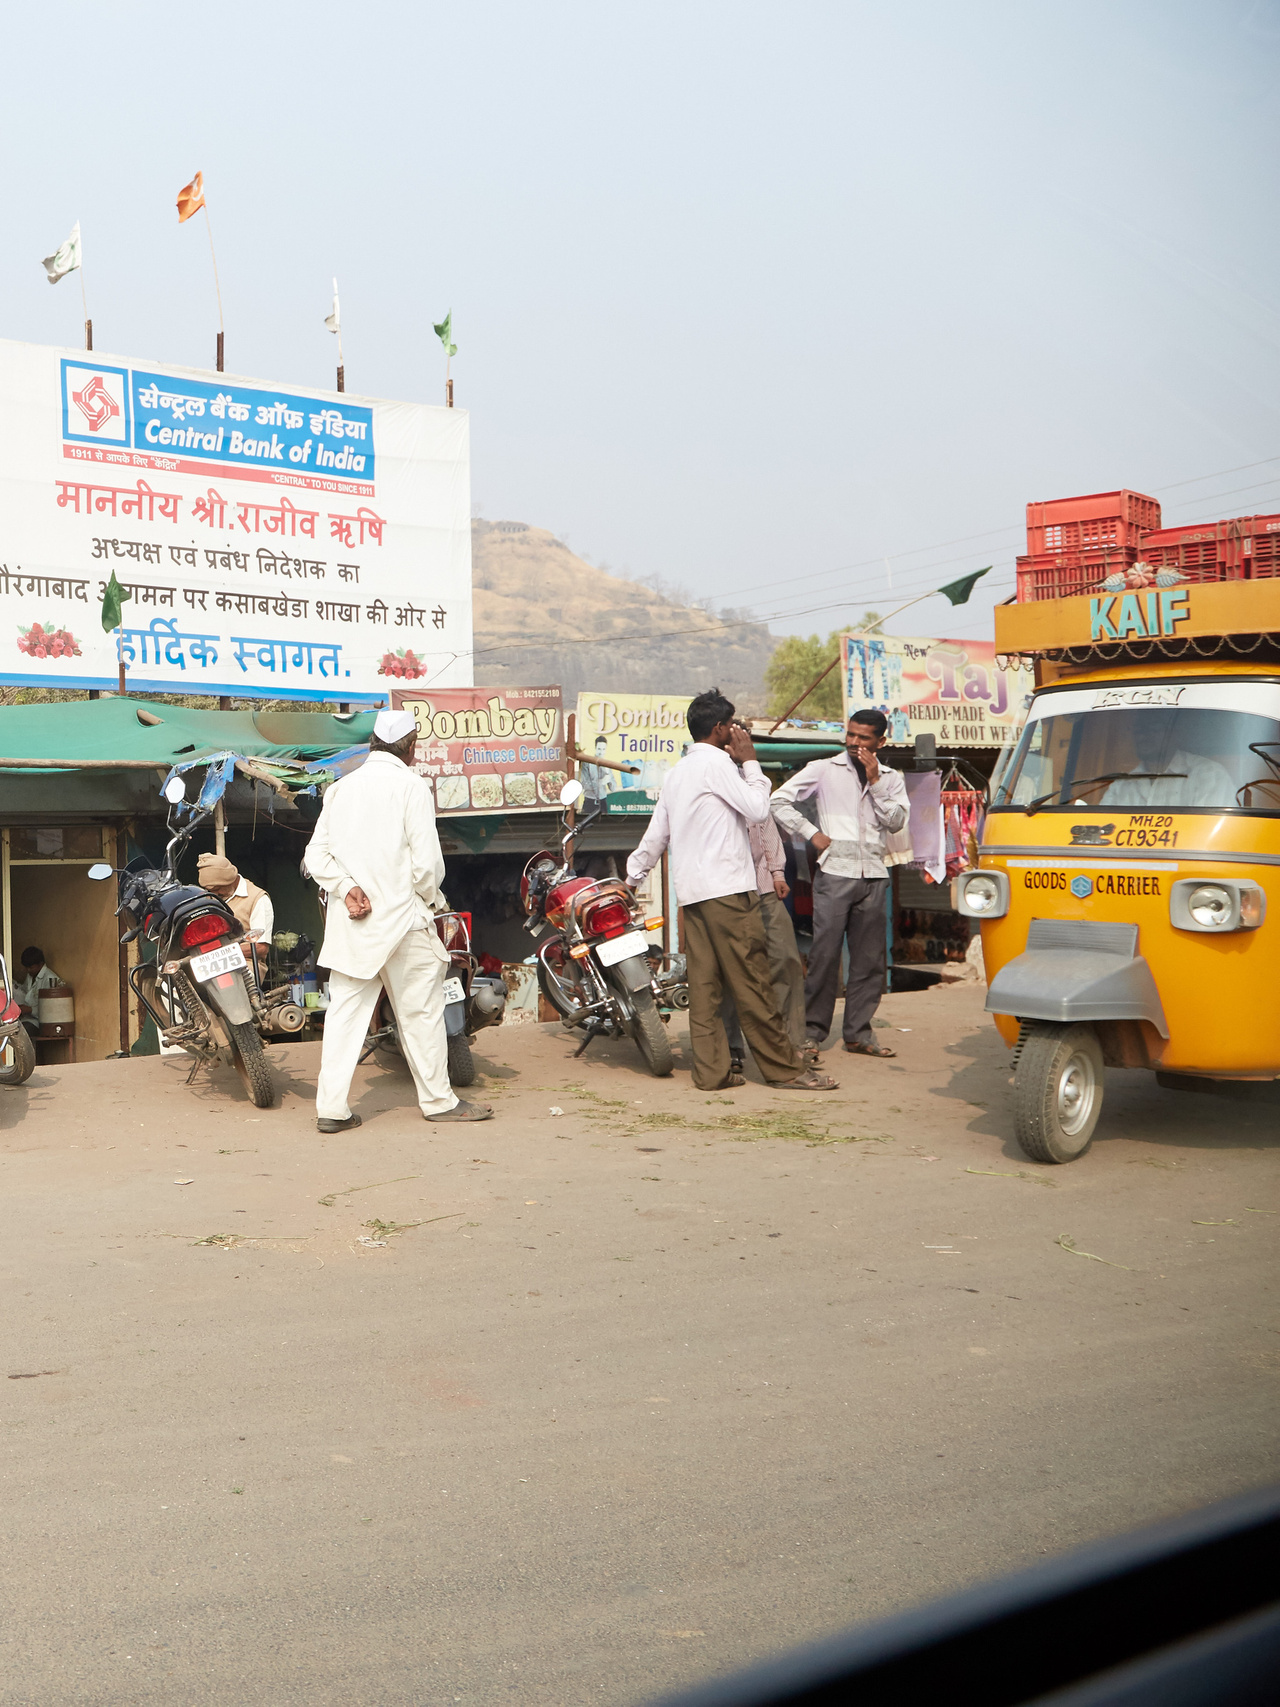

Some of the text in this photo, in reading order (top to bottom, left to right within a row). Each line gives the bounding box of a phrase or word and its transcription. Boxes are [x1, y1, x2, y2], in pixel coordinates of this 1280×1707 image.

[210, 392, 251, 422] बैंक
[309, 409, 367, 440] इंडिया
[144, 418, 367, 472] Central Bank of India
[70, 448, 92, 459] 1911
[94, 449, 103, 460] से
[106, 452, 130, 464] आपके
[132, 454, 149, 468] लिए
[311, 479, 322, 488] TO
[322, 480, 337, 491] YOU
[337, 483, 358, 494] SINCE
[358, 486, 373, 496] 1911
[55, 479, 183, 524] माननीय
[327, 506, 387, 549] ऋषि
[91, 537, 360, 584] अध्यक्ष एवं प्रबंध निदेशक का
[183, 588, 209, 612] पर
[215, 590, 309, 619] कसाबखेडा
[315, 600, 361, 624] शाखा
[366, 598, 388, 625] की
[394, 602, 426, 628] ओर
[431, 604, 447, 630] से
[1089, 589, 1190, 642] KAIF
[113, 617, 220, 671] हार्दिक
[904, 643, 930, 661] New
[926, 650, 1009, 717] Taj
[1091, 687, 1186, 710] KGN
[401, 696, 557, 745] Bombay
[587, 699, 686, 735] Bomba
[908, 704, 986, 722] READY-MADE
[618, 733, 675, 753] Taoilrs
[940, 725, 951, 740] &
[954, 725, 986, 742] FOOT
[464, 744, 561, 765] Chinese Center
[1129, 815, 1174, 828] MH.20
[1115, 829, 1179, 848] CT.9341
[1024, 871, 1162, 897] GOODS CARRIER
[190, 909, 209, 918] HONDA
